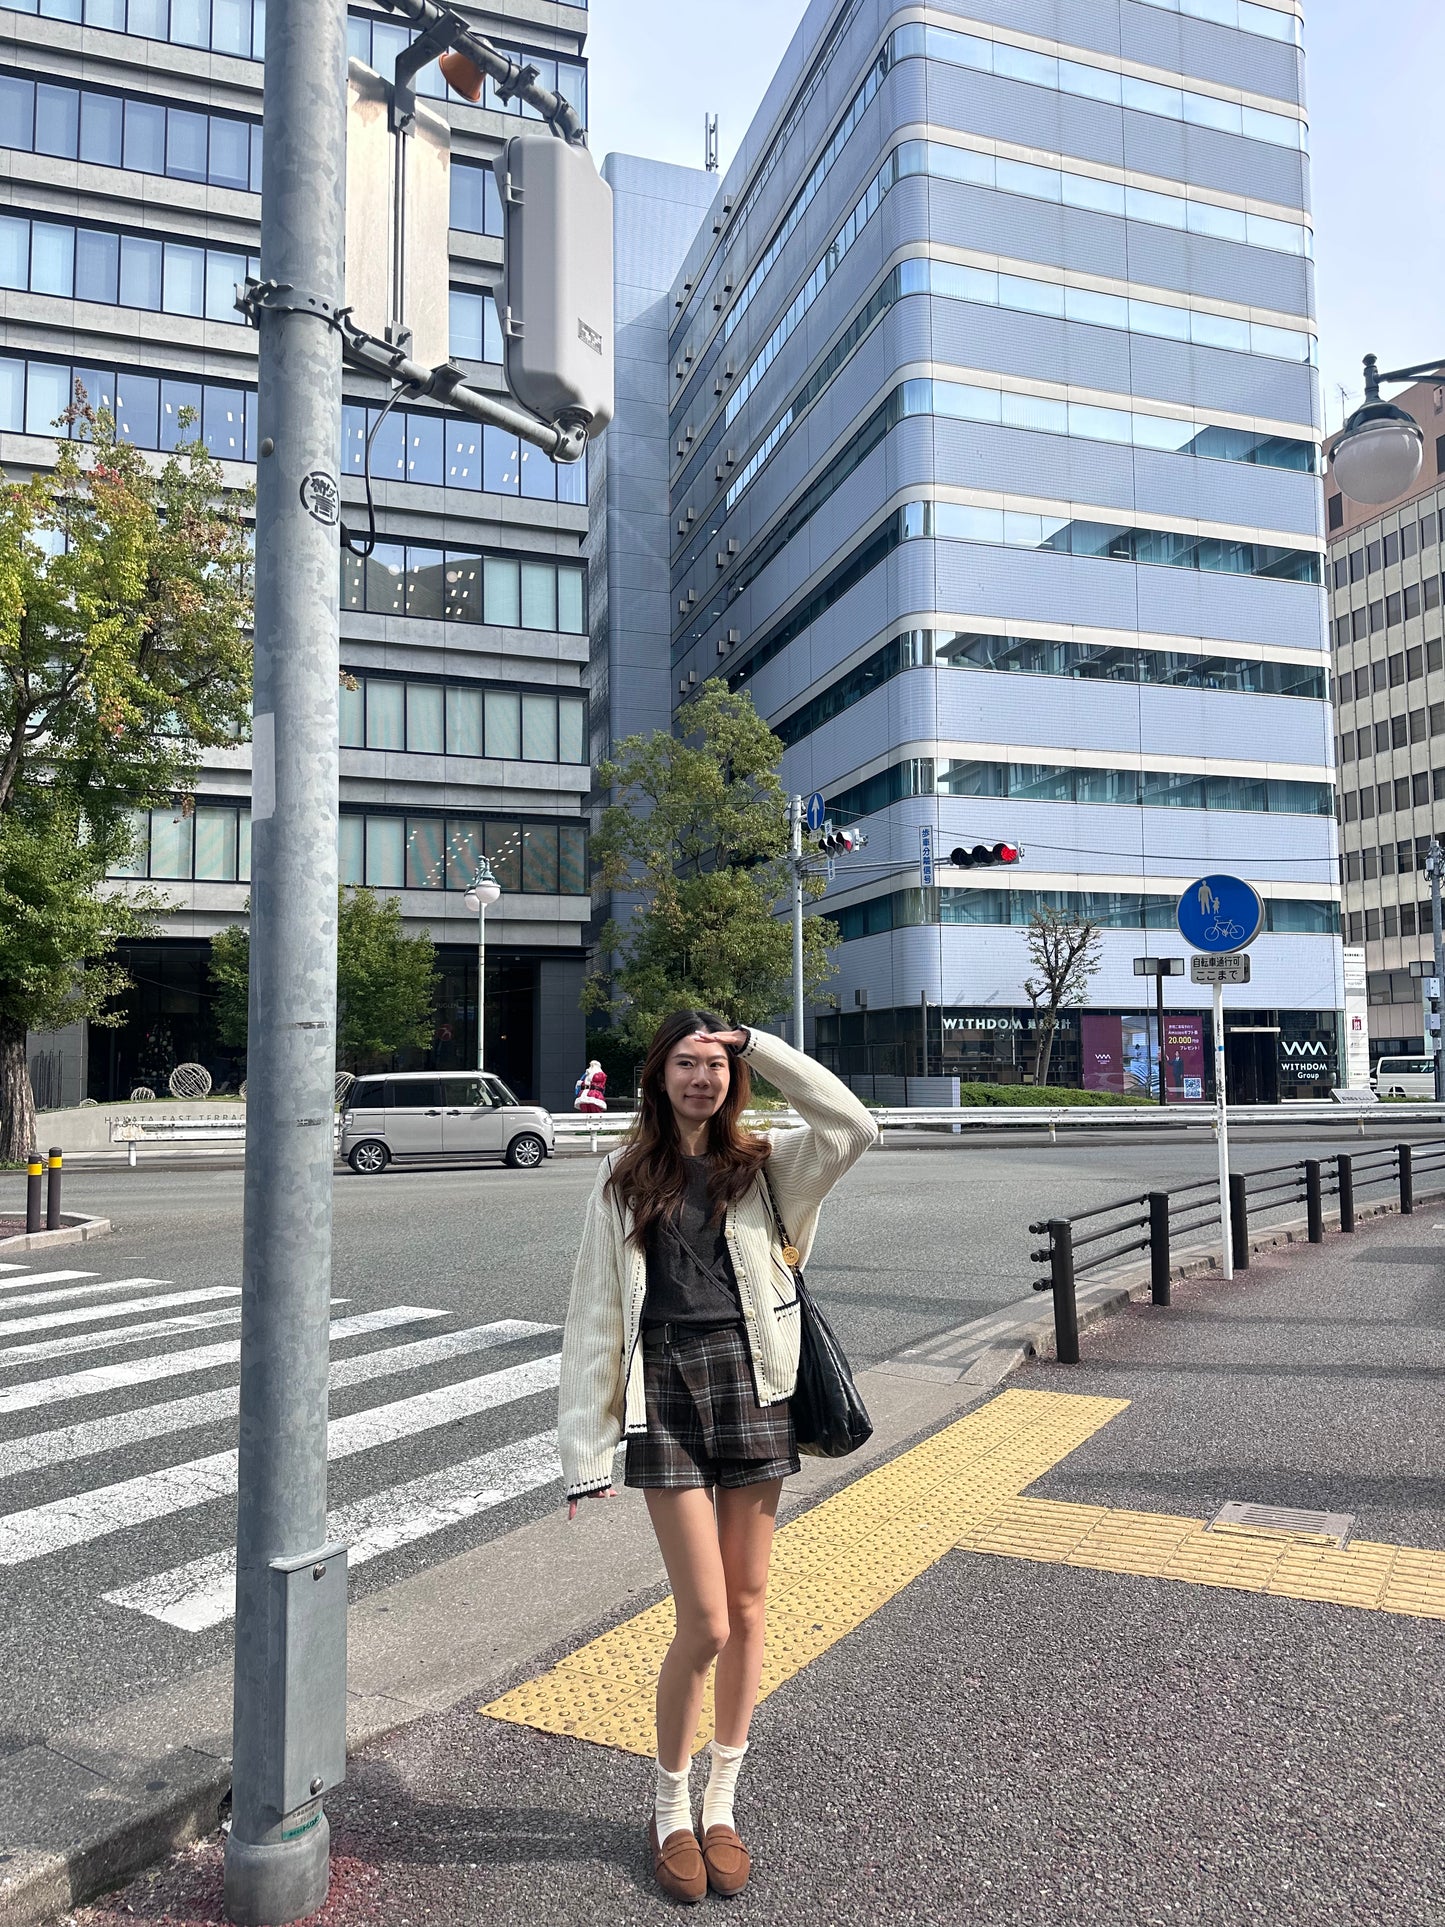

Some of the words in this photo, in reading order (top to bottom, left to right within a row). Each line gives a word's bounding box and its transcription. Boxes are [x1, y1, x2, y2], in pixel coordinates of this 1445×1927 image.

[1193, 956, 1240, 967] 自転車通行可
[1196, 970, 1238, 980] ここまで
[943, 1018, 1023, 1030] WITHDOM
[1281, 1063, 1328, 1071] WITHDOM
[1297, 1071, 1320, 1081] Group
